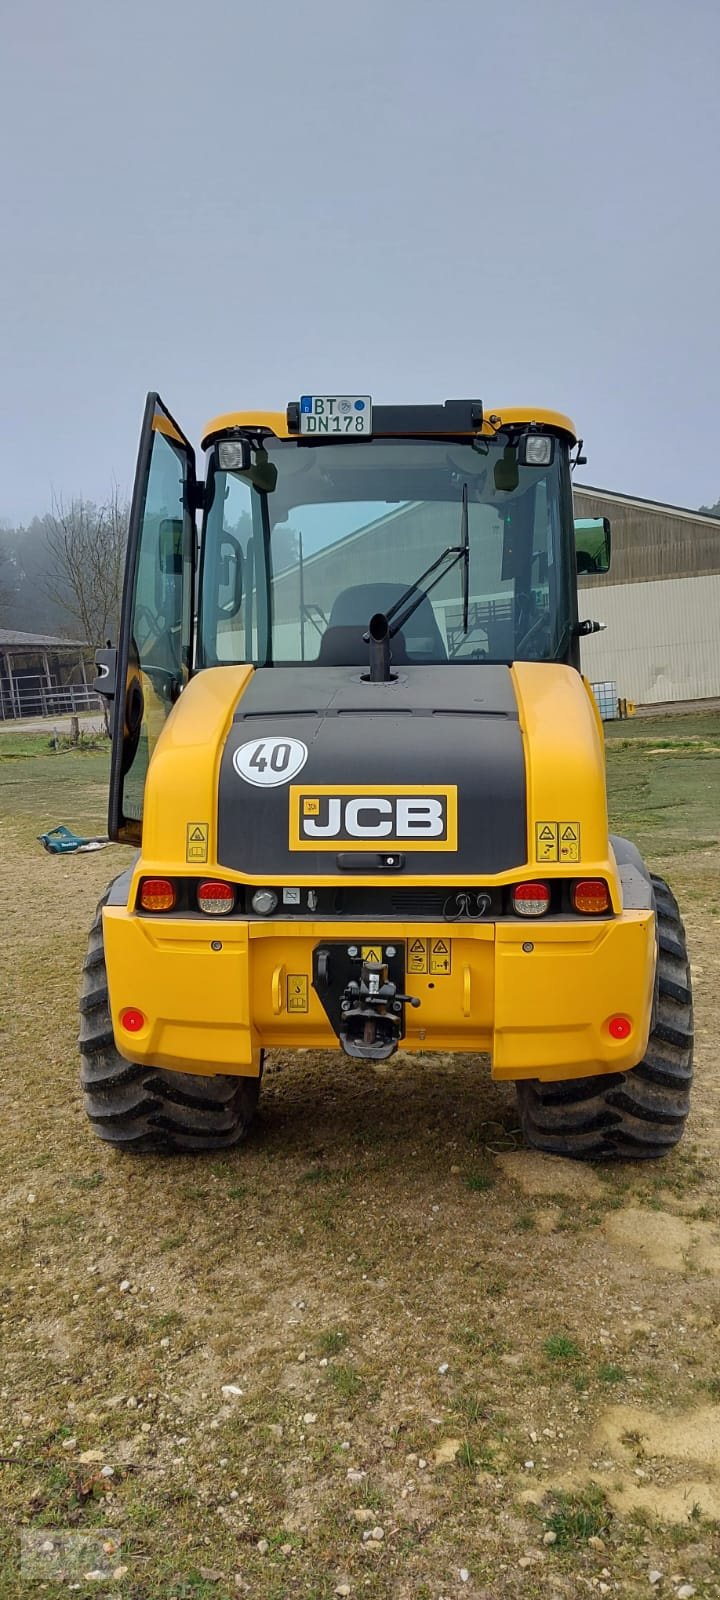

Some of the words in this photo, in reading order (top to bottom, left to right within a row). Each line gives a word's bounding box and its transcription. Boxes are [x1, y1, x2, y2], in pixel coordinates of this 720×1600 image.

[314, 398, 337, 415] BT
[306, 415, 364, 432] DN178
[249, 743, 292, 773] 40
[303, 798, 444, 837] JCB
